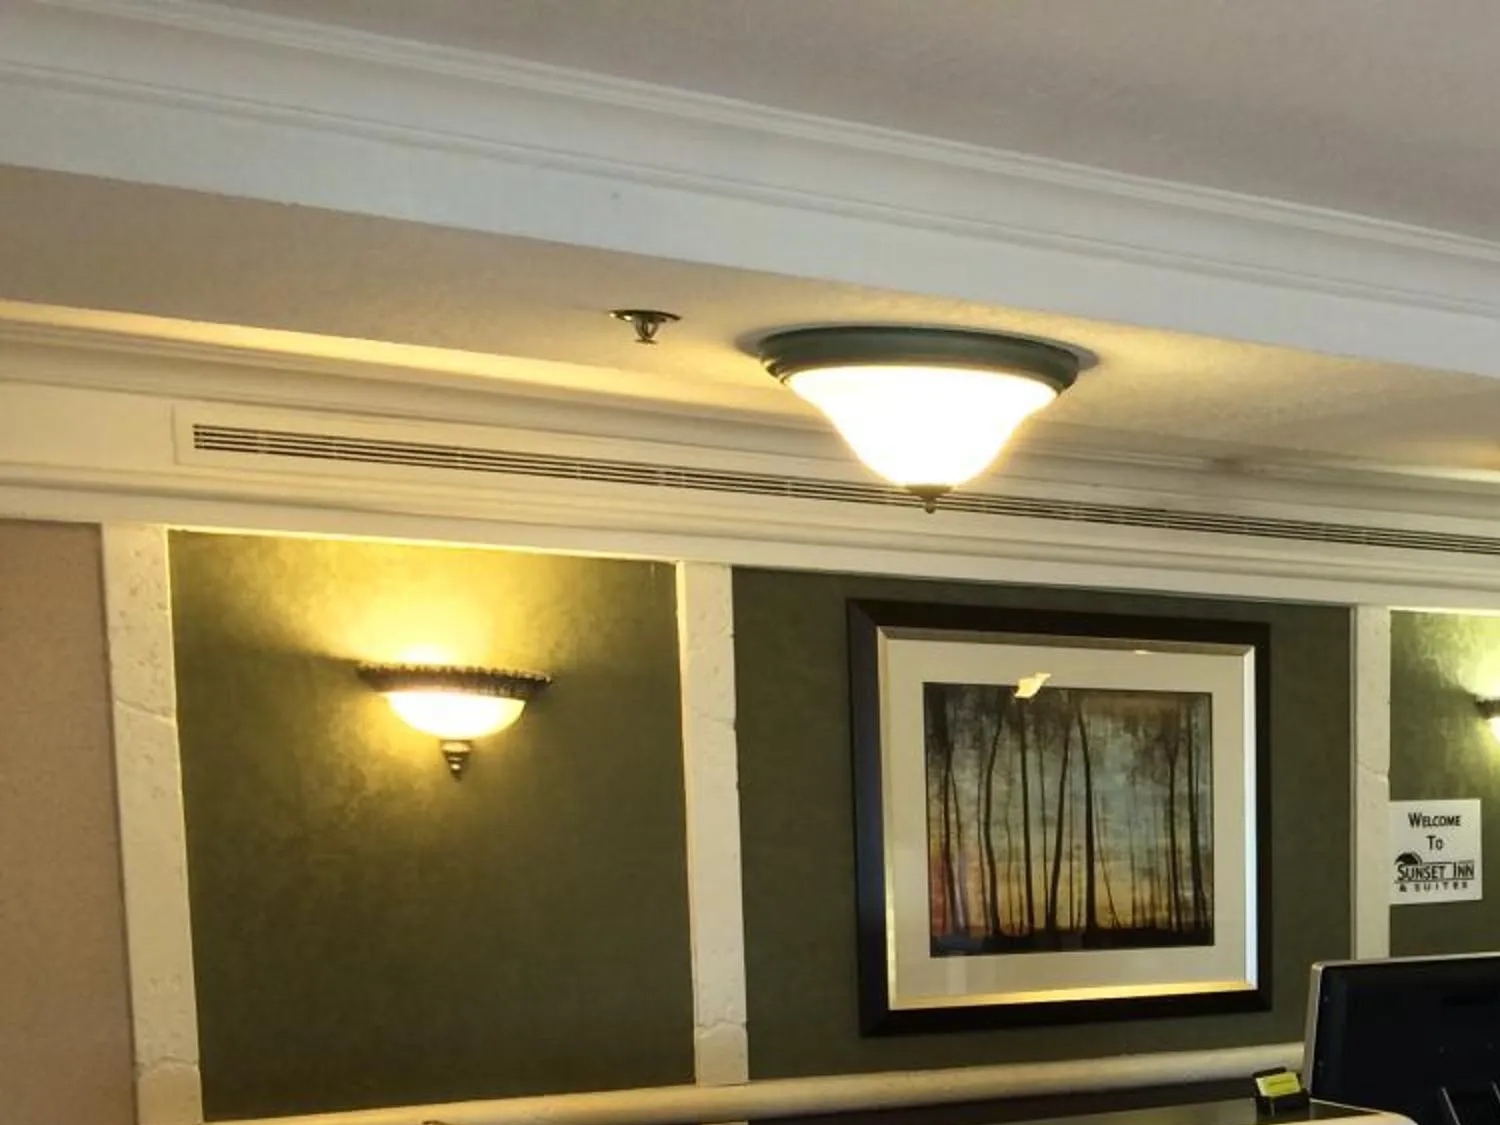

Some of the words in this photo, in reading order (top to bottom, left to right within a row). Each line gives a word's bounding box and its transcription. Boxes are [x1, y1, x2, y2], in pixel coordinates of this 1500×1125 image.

[1408, 812, 1461, 828] WELCOME
[1397, 862, 1446, 881] SUNSET
[1453, 862, 1474, 879] INN
